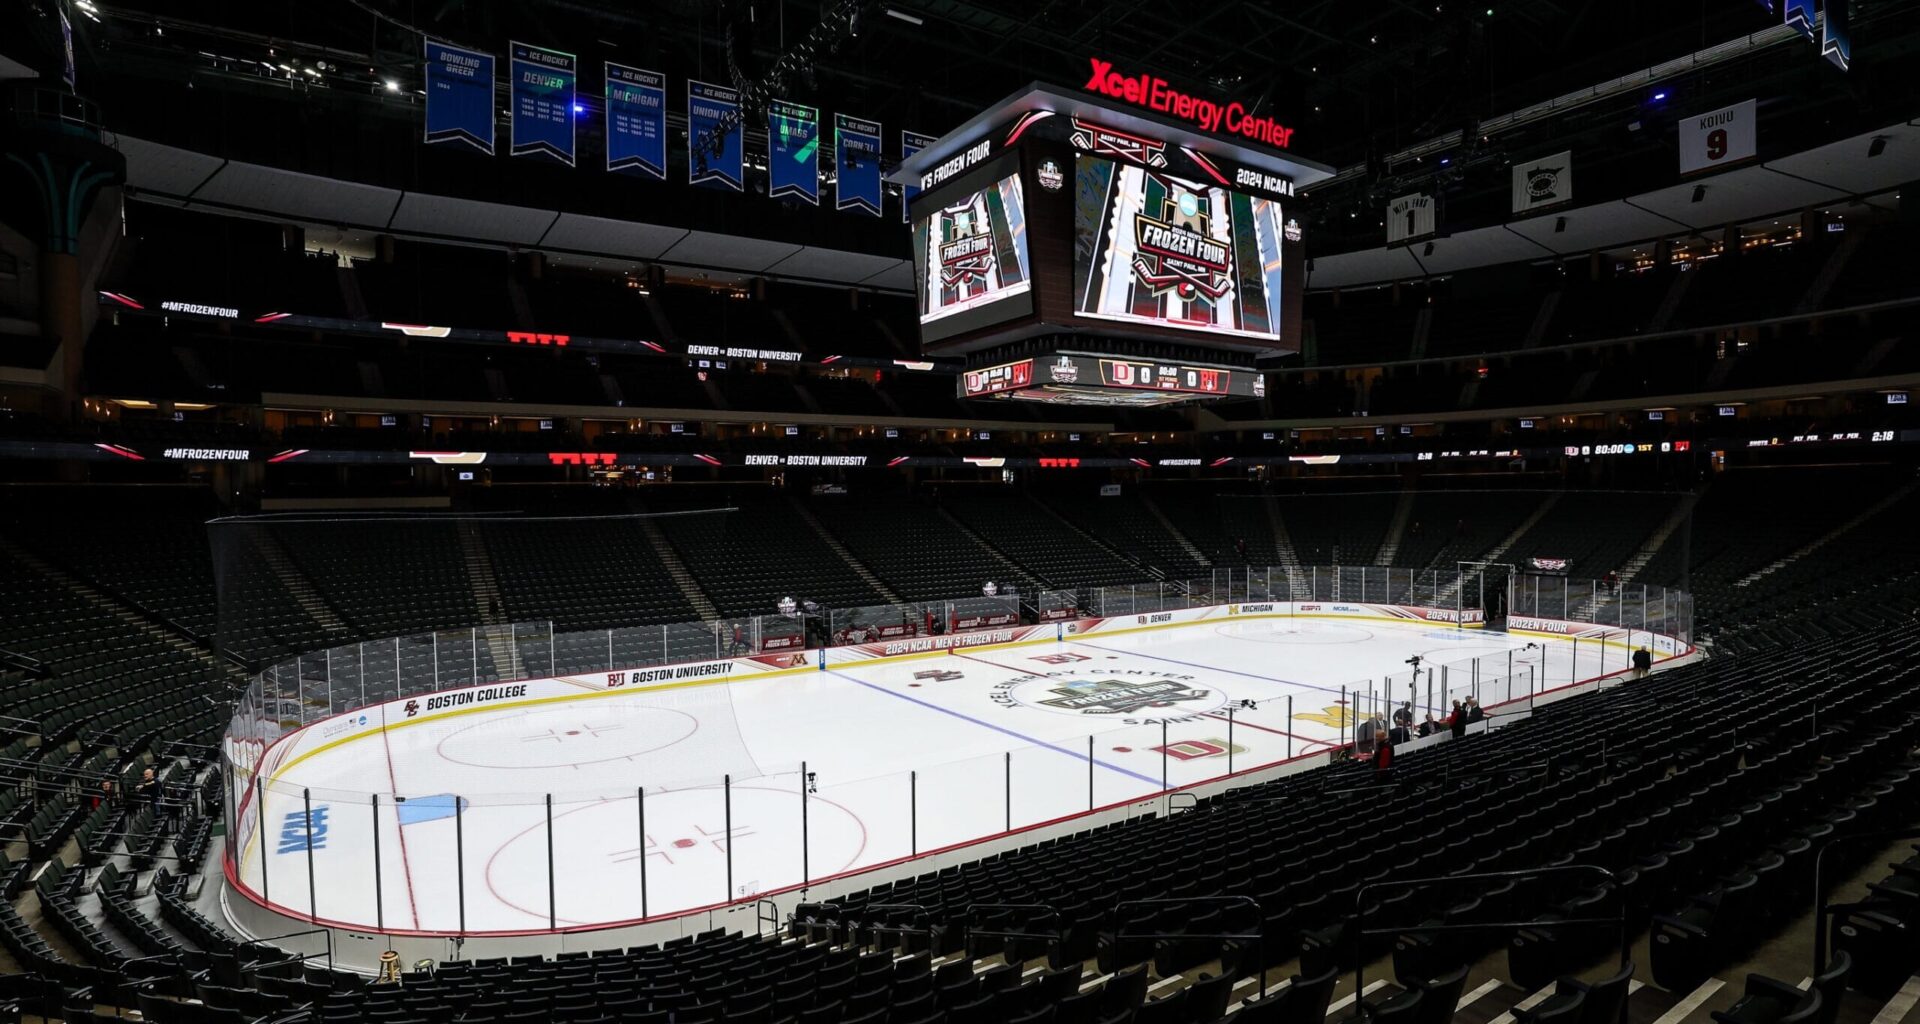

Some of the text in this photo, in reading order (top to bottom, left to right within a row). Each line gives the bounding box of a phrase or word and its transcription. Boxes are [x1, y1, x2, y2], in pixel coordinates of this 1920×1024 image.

[440, 52, 480, 68] BOWLING
[529, 51, 569, 66] ICE HOCKEY
[446, 64, 474, 77] GREEN
[622, 71, 659, 85] ICE HOCKEY
[523, 72, 563, 89] DENVER
[613, 89, 659, 107] MICHIGAN
[703, 88, 737, 101] ICE HOCKEY
[1085, 58, 1294, 148] Xcel Energy Center
[693, 105, 719, 120] UNION
[781, 106, 812, 119] ICE HOCKEY
[1700, 110, 1734, 130] KOIVU
[780, 125, 808, 139] UMASS
[848, 121, 876, 133] ICE HOCKEY
[1707, 129, 1727, 160] 9
[934, 154, 965, 185] FROZEN
[966, 139, 990, 167] FOUR
[1237, 168, 1262, 187] 2024
[1263, 175, 1288, 195] NCAA
[1393, 201, 1409, 215] WILD
[1406, 209, 1415, 235] 1
[1172, 227, 1202, 241] 2024 MEN'S
[944, 237, 988, 260] FROZEN FOUR
[1143, 225, 1226, 265] FROZEN FOUR
[1166, 258, 1183, 268] SAINT
[1183, 262, 1199, 271] PAUL,
[161, 301, 239, 319] #MFROZENFOUR
[687, 345, 719, 356] DENVER
[727, 347, 758, 358] BOSTON
[758, 350, 802, 361] UNIVERSITY
[1141, 367, 1150, 384] 0
[1187, 371, 1197, 387] 0
[163, 448, 250, 460] #MFROZENFOUR
[1594, 444, 1624, 455] 80:00
[1637, 444, 1653, 452] 1ST
[745, 455, 779, 466] DENVER
[787, 455, 821, 466] BOSTON
[821, 456, 867, 466] UNIVERSITY
[1242, 604, 1274, 613] MICHIGAN
[1426, 611, 1449, 621] 2024
[1150, 613, 1172, 623] DENVER
[1542, 621, 1568, 633] FOUR
[885, 631, 1013, 655] 2024 NCAA MEN'S FROZEN FOUR
[632, 668, 674, 684] BOSTON
[676, 662, 733, 679] UNIVERSITY
[1090, 670, 1195, 680] CENTER
[427, 690, 473, 711] BOSTON
[477, 684, 527, 701] COLLEGE
[1122, 712, 1204, 725] SAINT
[277, 804, 330, 855] NCAA
